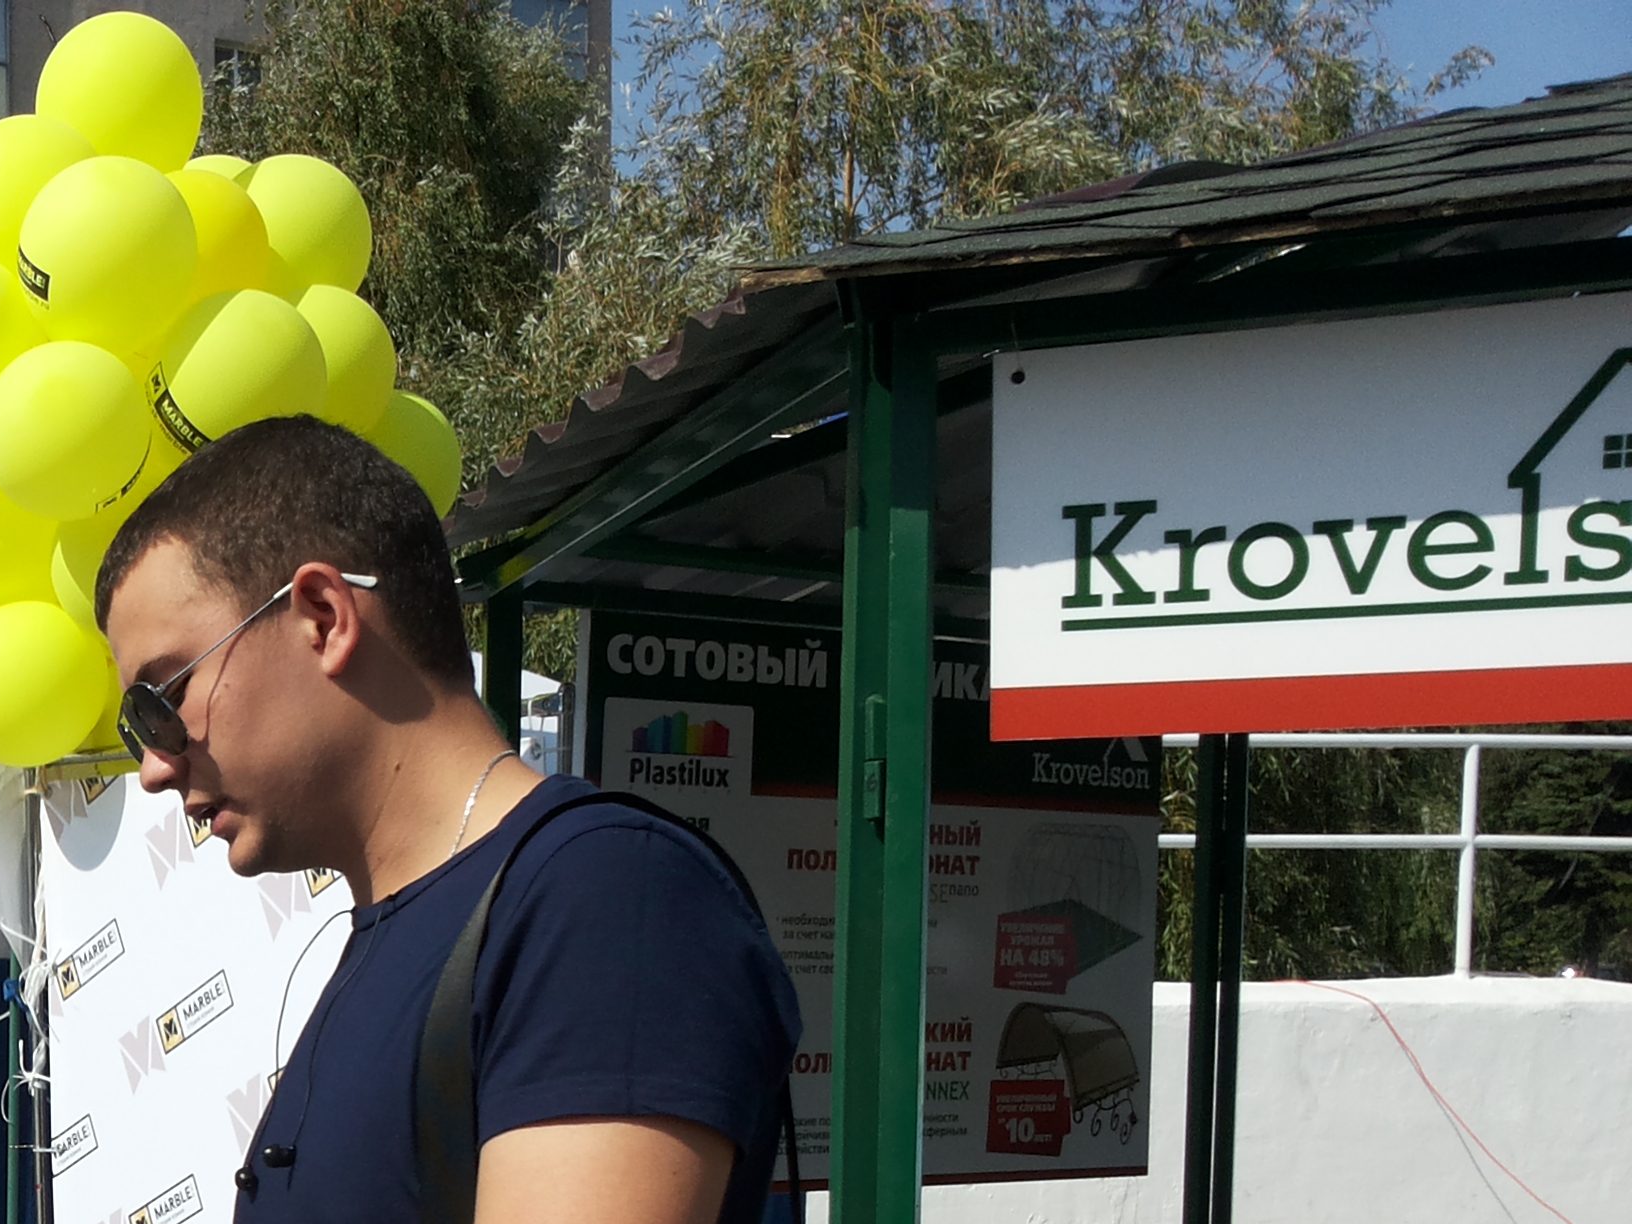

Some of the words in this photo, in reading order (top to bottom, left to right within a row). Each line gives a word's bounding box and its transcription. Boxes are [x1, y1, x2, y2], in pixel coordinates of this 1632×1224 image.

[162, 399, 204, 448] MARBLE
[607, 634, 827, 688] СОТОВЫЙ
[630, 757, 729, 788] Plastilux
[1032, 752, 1150, 789] Krovelson
[929, 820, 981, 846] НЫЙ
[787, 849, 837, 872] ПОЛ
[77, 929, 116, 969] MARBLE
[1000, 949, 1025, 966] НА
[1028, 949, 1064, 966] 48%
[182, 981, 223, 1021] MARBLE
[925, 1016, 972, 1043] КИЙ
[926, 1081, 971, 1100] NNEX
[1006, 1118, 1035, 1143] 10
[154, 1185, 193, 1220] MARBLE
